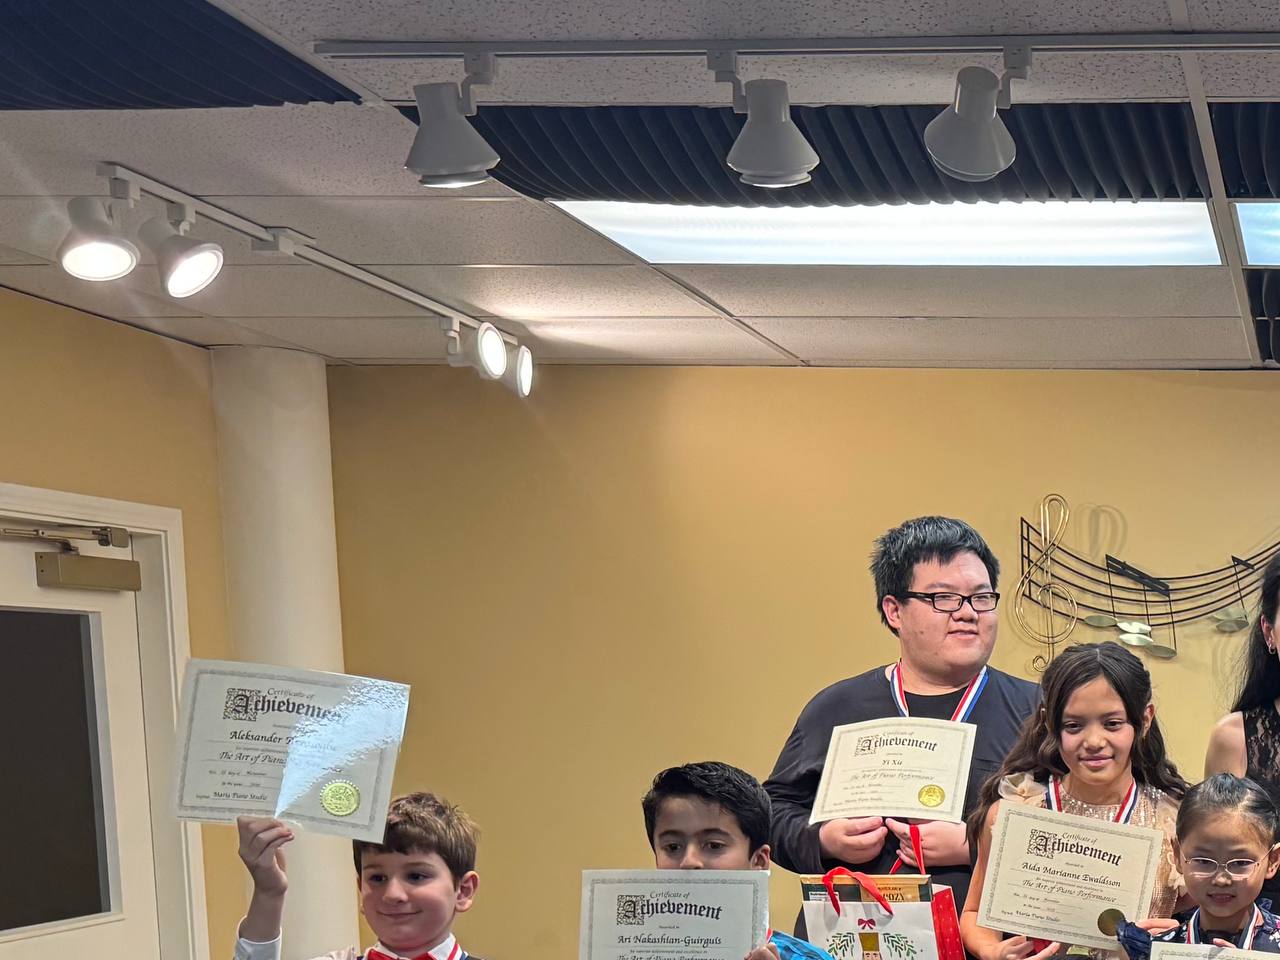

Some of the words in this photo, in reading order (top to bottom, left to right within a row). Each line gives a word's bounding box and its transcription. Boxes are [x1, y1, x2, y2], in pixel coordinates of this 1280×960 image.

[229, 730, 282, 744] Aleksander
[860, 736, 938, 752] Achievement
[219, 751, 233, 761] The
[235, 751, 249, 761] Art
[250, 753, 260, 766] of
[1034, 835, 1122, 866] Achievement
[1042, 865, 1081, 880] Marianne
[1081, 874, 1121, 887] Ewaldsson
[649, 891, 682, 899] Certificate
[1022, 879, 1034, 887] The
[1035, 882, 1047, 890] Art
[1047, 885, 1056, 894] of
[1055, 886, 1076, 895] Piano
[1076, 889, 1117, 903] Performance
[623, 898, 723, 920] Achievement
[617, 935, 631, 944] Ari
[633, 933, 722, 949] Nakashian-Guirguis
